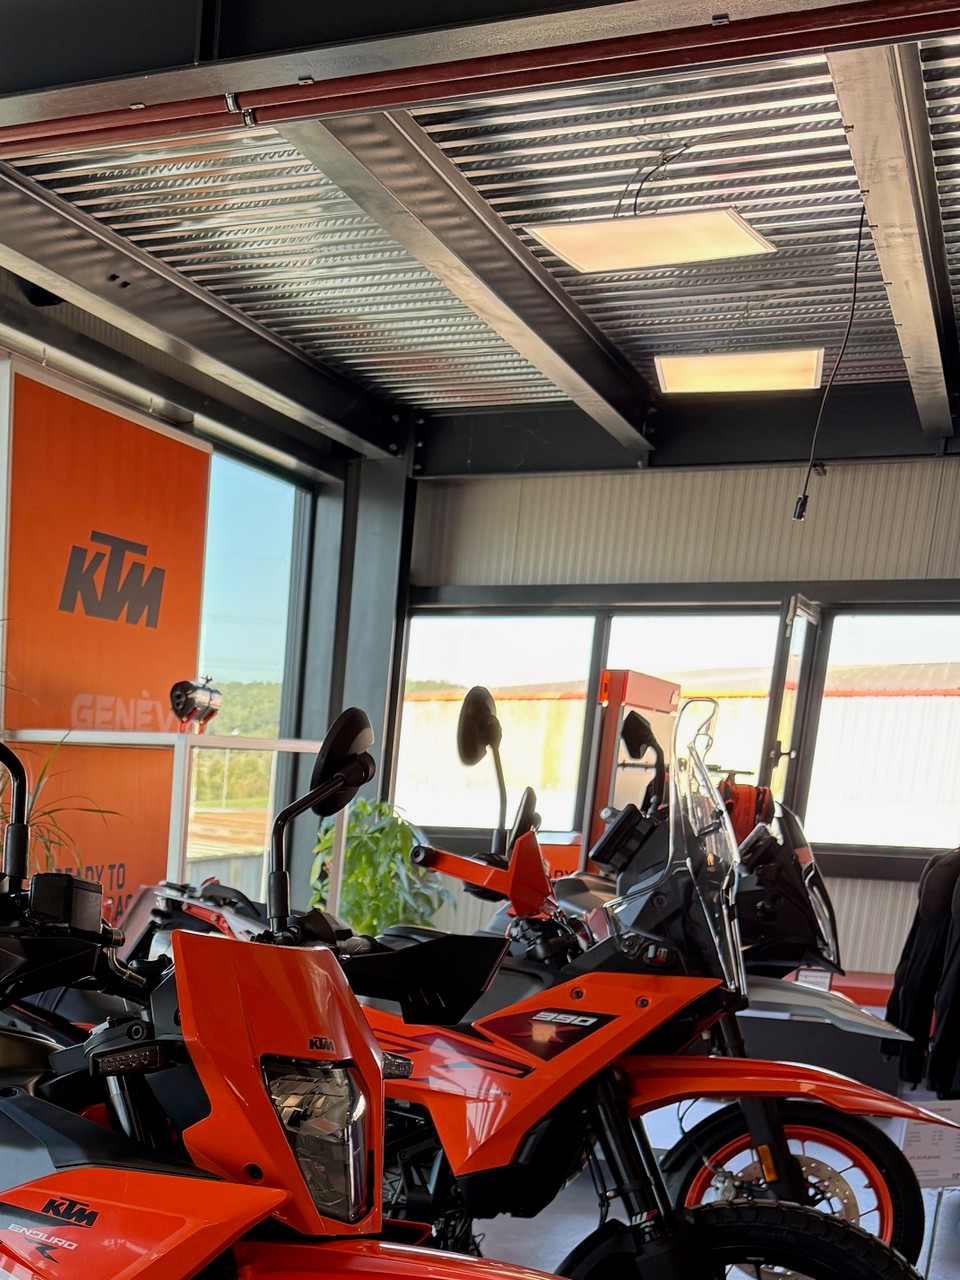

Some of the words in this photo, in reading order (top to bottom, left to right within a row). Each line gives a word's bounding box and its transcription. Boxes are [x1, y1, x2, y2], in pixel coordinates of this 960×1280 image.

[58, 530, 165, 629] KTM
[70, 690, 175, 732] GENÈV
[108, 863, 125, 890] TO
[532, 1011, 599, 1026] 390
[309, 1036, 335, 1051] KTM
[41, 1196, 99, 1226] KTM
[8, 1223, 78, 1250] ENDURO
